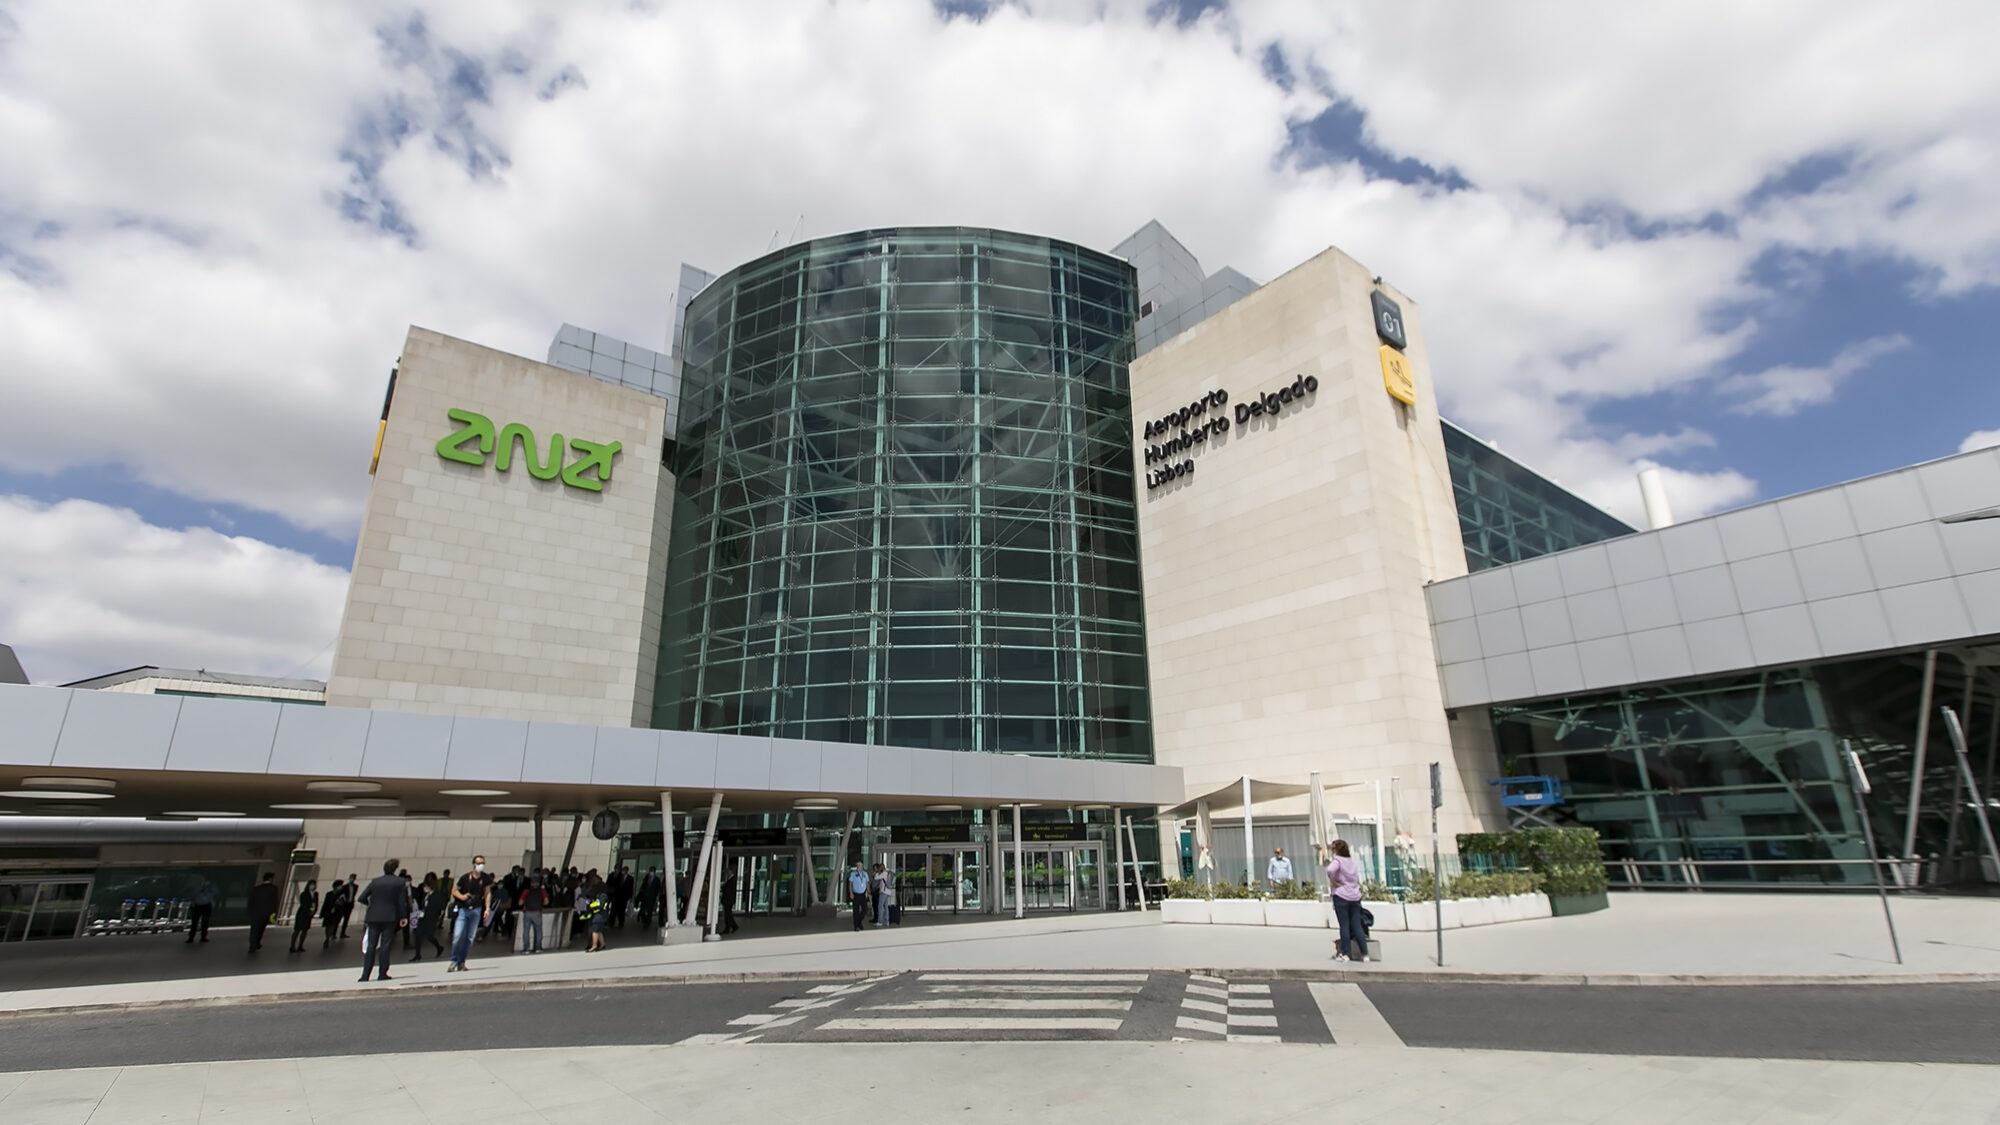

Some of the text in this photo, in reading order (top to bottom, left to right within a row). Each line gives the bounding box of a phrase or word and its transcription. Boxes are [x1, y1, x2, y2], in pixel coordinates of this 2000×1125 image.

[1144, 388, 1229, 440] Aeroporto
[1144, 373, 1319, 466] Humberto Delgado
[1146, 458, 1195, 489] Lisboa
